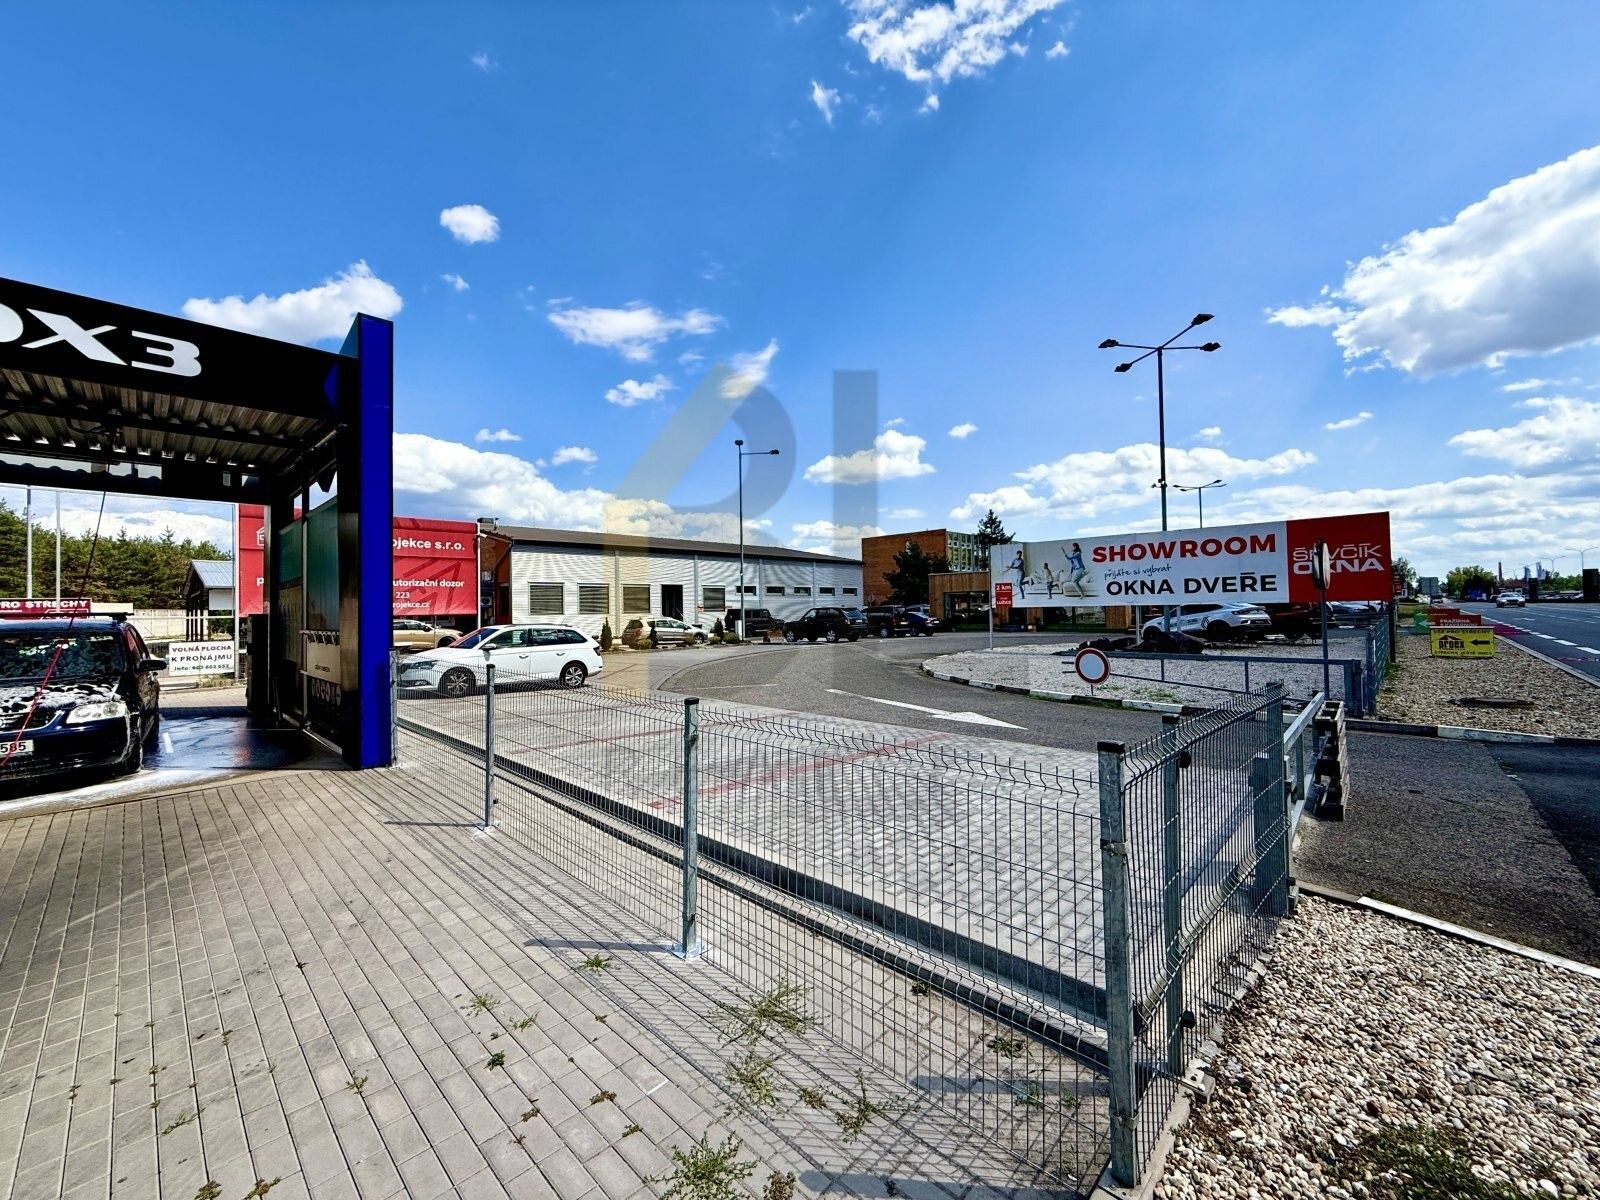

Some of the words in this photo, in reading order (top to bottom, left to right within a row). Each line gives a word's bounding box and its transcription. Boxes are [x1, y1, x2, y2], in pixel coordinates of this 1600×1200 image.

[434, 541, 466, 551] s.r.o.
[1092, 533, 1276, 563] SHOWROOM
[1133, 566, 1141, 576] si
[1143, 563, 1172, 577] vybrat
[440, 579, 465, 587] dozor
[1106, 579, 1175, 596] OKNA
[1183, 572, 1278, 594] DVEŘE
[395, 591, 410, 599] 223
[180, 654, 233, 662] PRONÁJMU
